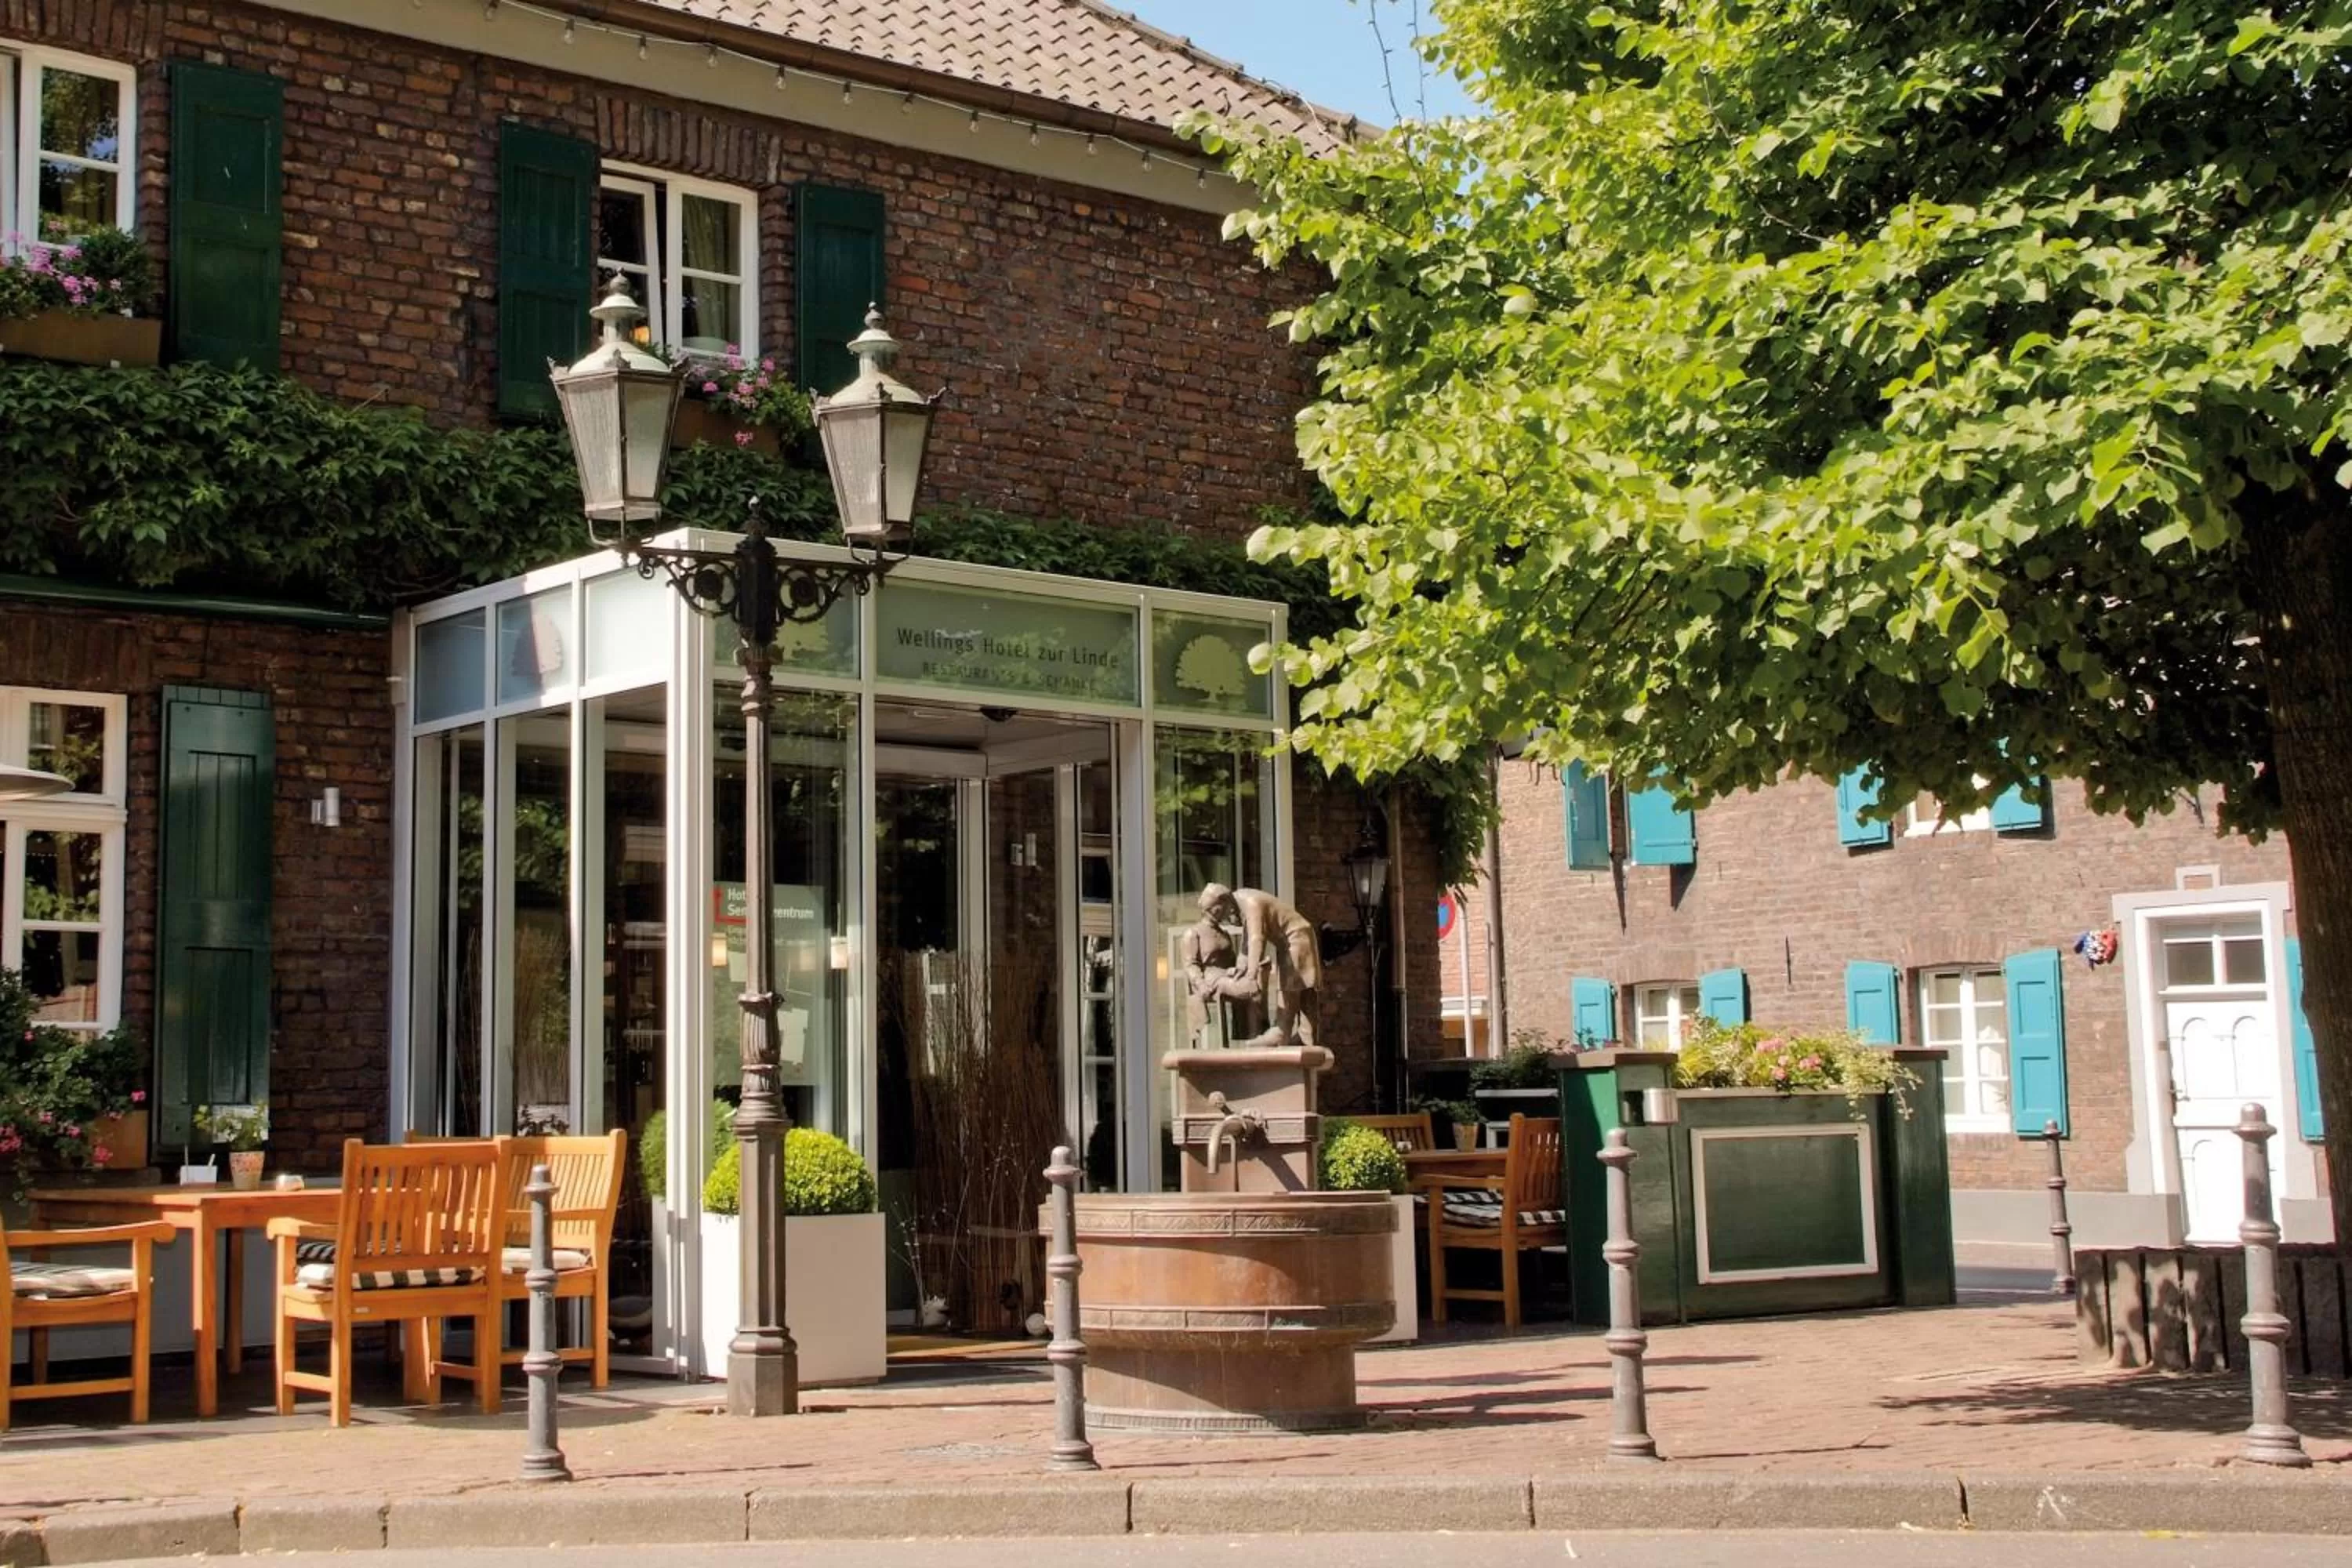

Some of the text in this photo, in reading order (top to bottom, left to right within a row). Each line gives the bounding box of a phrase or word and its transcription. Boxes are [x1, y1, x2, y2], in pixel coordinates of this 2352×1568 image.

[896, 626, 1119, 669] Wellings Hotel zur Linde
[727, 887, 746, 901] Hot
